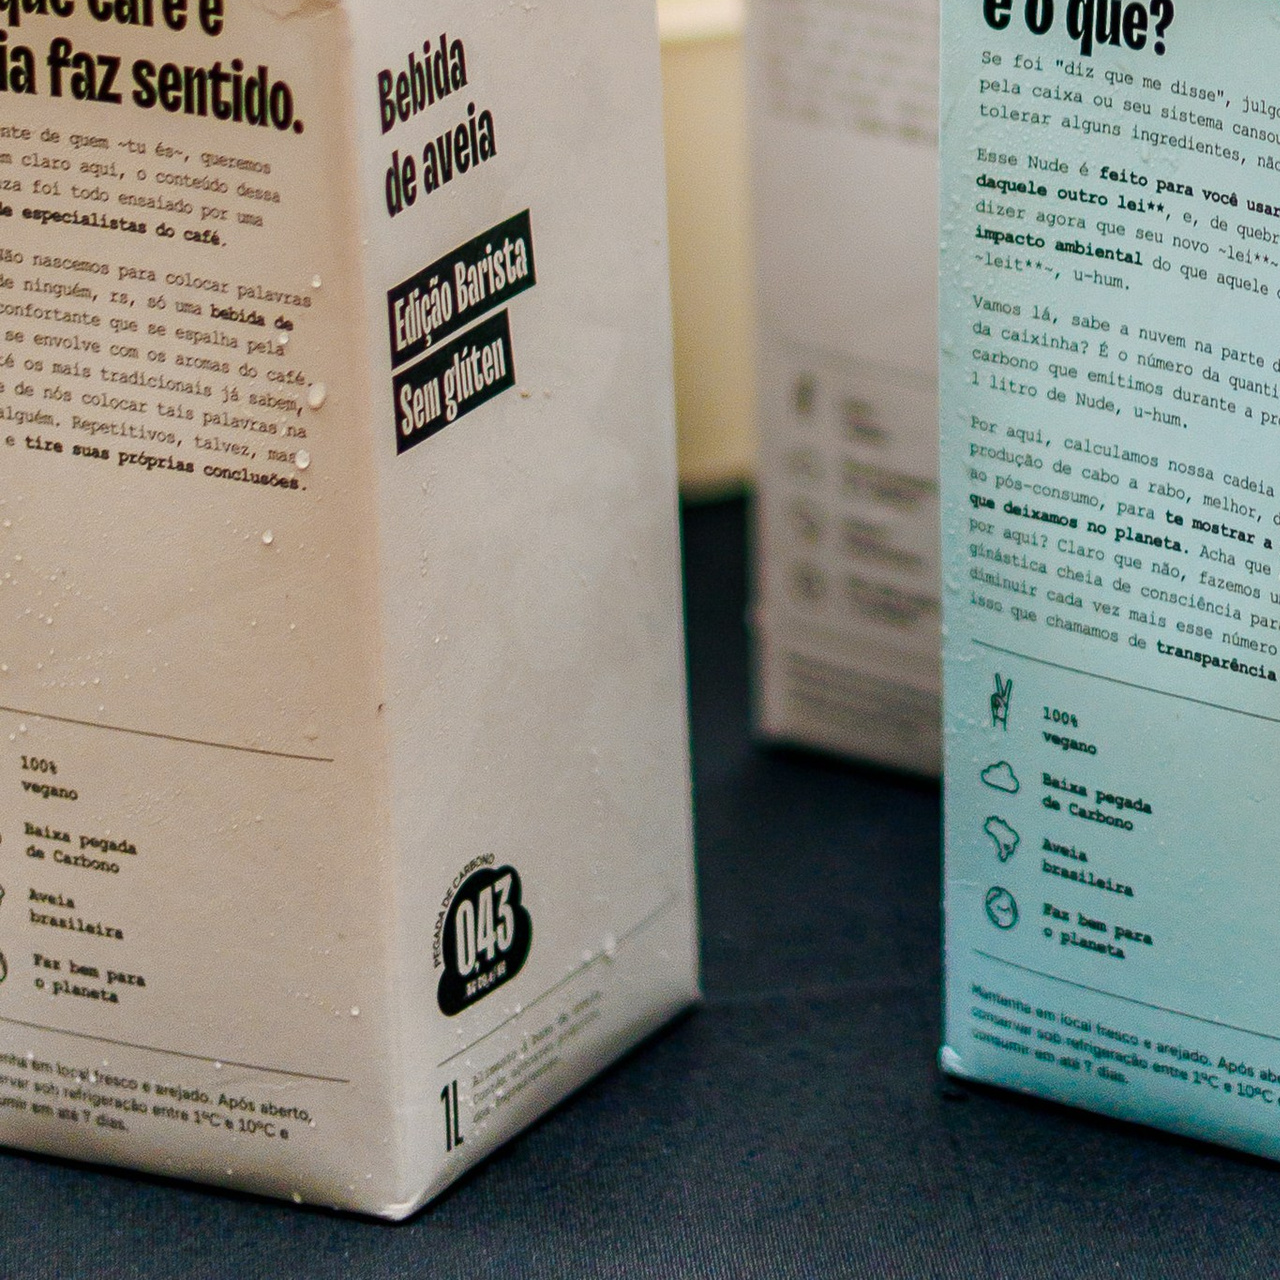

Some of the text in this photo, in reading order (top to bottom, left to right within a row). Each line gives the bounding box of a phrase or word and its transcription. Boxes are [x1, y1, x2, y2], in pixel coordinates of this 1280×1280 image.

[47, 36, 122, 105] faz
[132, 58, 304, 134] sentido.
[377, 32, 468, 135] Bebida
[981, 50, 1002, 66] Se
[1013, 54, 1044, 72] foi
[1056, 59, 1094, 79] "diz
[1104, 69, 1134, 86] que
[1142, 75, 1162, 91] me
[979, 78, 1022, 95] pela
[1032, 85, 1083, 104] caixa
[1093, 95, 1113, 108] ou
[1123, 99, 1152, 116] seu
[1161, 105, 1223, 131] sistema
[980, 103, 1051, 126] tolerar
[1061, 115, 1122, 138] alguns
[1132, 125, 1246, 166] ingredientes,
[385, 101, 497, 218] de aveia
[976, 148, 1018, 166] Esse
[1027, 155, 1069, 174] Nude
[1079, 162, 1089, 177] é
[1099, 166, 1148, 187] feito
[1156, 178, 1194, 197] para
[1202, 188, 1239, 208] você
[394, 237, 529, 352] Edição Barista
[972, 295, 1021, 316] Vamos
[1032, 305, 1058, 325] lá,
[1071, 315, 1111, 332] sabe
[1119, 324, 1129, 336] a
[1138, 327, 1187, 348] nuvem
[1194, 339, 1213, 355] na
[1221, 346, 1265, 368] parte
[33, 333, 101, 354] envolve
[109, 343, 139, 359] com
[175, 352, 230, 374] aromas
[238, 362, 258, 379] do
[52, 362, 92, 379] mais
[101, 367, 212, 397] tradicionais
[401, 337, 506, 437] Sem glúten
[25, 435, 63, 454] tire
[72, 442, 110, 461] suas
[1010, 604, 1037, 622] que
[1046, 612, 1119, 643] chamamos
[1128, 632, 1147, 650] de
[1042, 706, 1079, 728] 100%
[1042, 730, 1098, 756] vegano
[21, 780, 79, 802] vegano
[1096, 790, 1152, 814] pegada
[1068, 802, 1134, 832] Carbono
[53, 849, 120, 874] Carbono
[79, 833, 138, 856] pegada
[455, 873, 514, 977] 0,43
[1113, 924, 1153, 946] para
